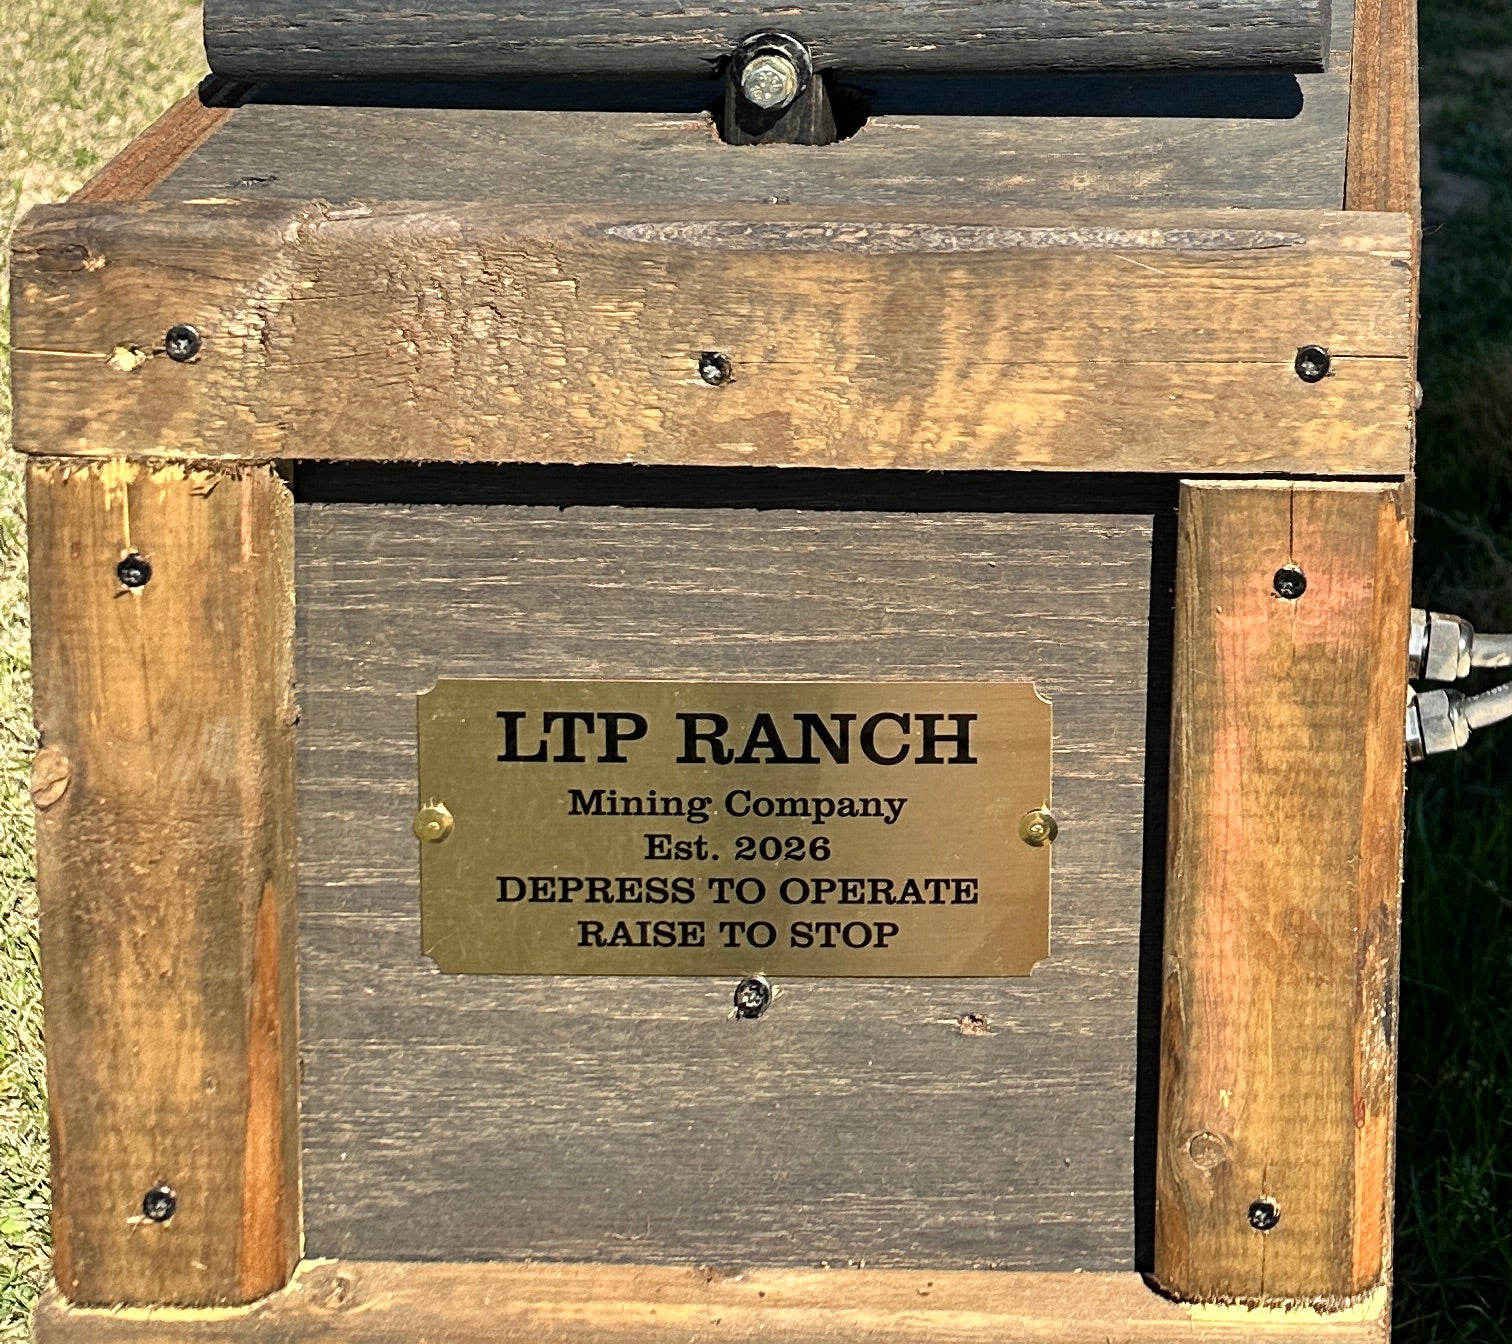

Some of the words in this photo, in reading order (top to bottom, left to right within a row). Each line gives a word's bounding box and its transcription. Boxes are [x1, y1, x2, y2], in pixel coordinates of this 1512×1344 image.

[496, 711, 648, 763] LTP
[676, 712, 978, 765] RANCH
[567, 788, 713, 824] Mining
[724, 789, 908, 824] Company
[643, 833, 719, 862] Est.
[734, 835, 831, 862] 2026
[496, 876, 696, 905] DEPRESS
[707, 877, 767, 905] TO
[779, 877, 979, 906] OPERATE
[576, 920, 706, 948] RAISE
[718, 920, 777, 949] TO
[790, 921, 900, 949] STOP
